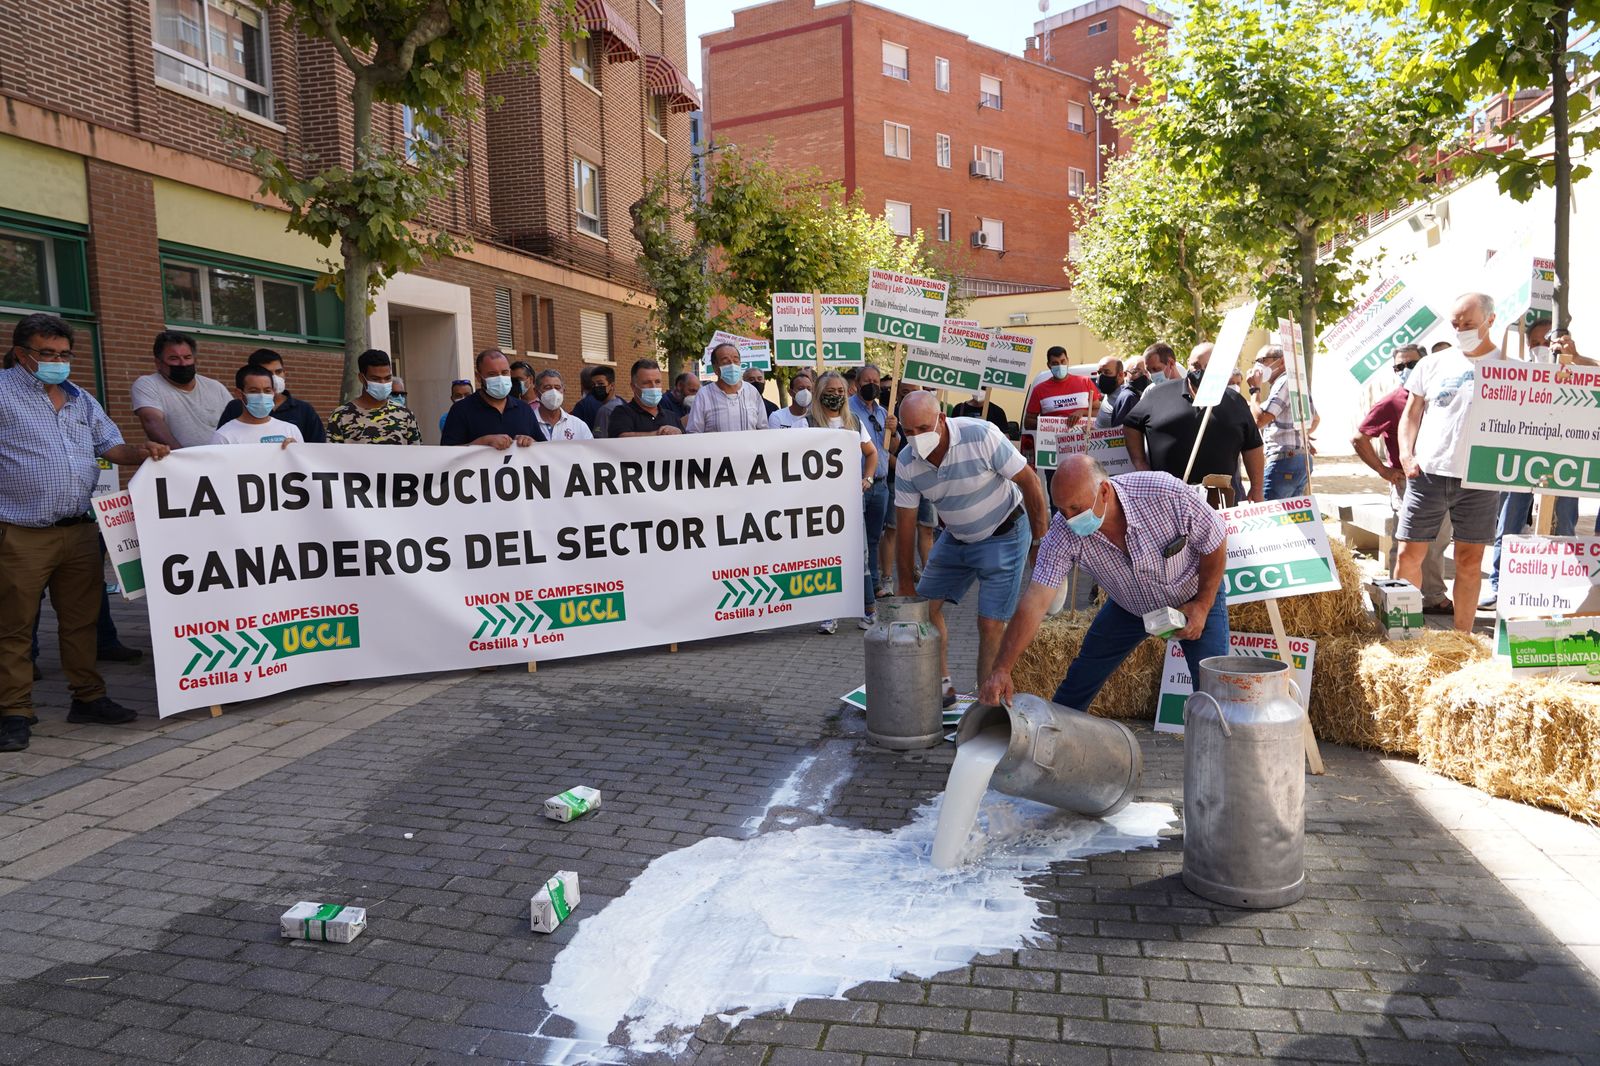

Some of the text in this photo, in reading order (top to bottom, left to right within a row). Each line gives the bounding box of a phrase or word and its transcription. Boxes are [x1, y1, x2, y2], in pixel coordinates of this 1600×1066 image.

[871, 280, 888, 291] Castilla
[892, 284, 904, 293] León
[872, 271, 946, 291] UNION DE CAMPESINOS
[776, 296, 859, 305] UNION DE MPESINOS
[925, 291, 943, 299] UCCL
[777, 306, 797, 315] Castilla
[838, 307, 857, 315] UCCL
[874, 299, 887, 307] Título
[921, 308, 939, 318] siempre
[1326, 322, 1347, 343] UNION
[1347, 311, 1358, 324] DE
[1356, 274, 1400, 315] CAMPESINOS
[783, 324, 798, 332] Título
[799, 324, 816, 334] Princi
[837, 325, 857, 335] siempre
[877, 317, 926, 340] UCCL
[947, 327, 990, 341] CAMPESINOS
[791, 343, 846, 359] UCCL
[968, 341, 986, 349] UCCL
[1014, 345, 1030, 353] UCCL
[1363, 324, 1423, 371] UCCL
[963, 357, 981, 366] siempre
[918, 365, 966, 386] UCCL
[983, 368, 1013, 385] CCL
[1481, 366, 1528, 381] UNION
[1532, 369, 1550, 383] DE
[1481, 383, 1553, 406] Castilla y León
[1057, 428, 1125, 443] UNION DE AMPESINO
[1480, 421, 1486, 432] a
[1488, 418, 1516, 434] Título
[1518, 420, 1563, 440] Principal,
[1565, 428, 1590, 440] como
[1109, 458, 1129, 467] siempre
[1495, 453, 1600, 489] UCCL
[156, 448, 844, 519] LA DISTRIBUCIÓN ARRUINA A LOS
[1234, 499, 1312, 519] CAMPESINOS
[1280, 512, 1310, 525] UCCL
[117, 539, 139, 552] a Títu
[161, 504, 845, 595] GANADEROS DEL SECTOR LACTEO
[1226, 537, 1317, 559] incipal, como siempre
[1509, 542, 1558, 554] UNION
[1564, 542, 1585, 556] DE
[712, 556, 842, 580] UNION DE CAMPESINOS
[1508, 558, 1589, 579] Castilla y León
[789, 571, 837, 595] UCCL
[464, 580, 624, 606] UNION DE CAMPESINOS
[1510, 595, 1516, 605] a
[1518, 592, 1550, 607] Título
[560, 597, 619, 624] UCCL
[714, 603, 792, 621] Castilla y León
[174, 603, 359, 638] UNION DE CAMPESINOS
[282, 622, 352, 653] UCCL
[469, 632, 564, 651] Castilla y León
[1230, 635, 1309, 653] CAMPESOS
[178, 662, 287, 691] Castilla y León
[1170, 672, 1192, 684] a Títu
